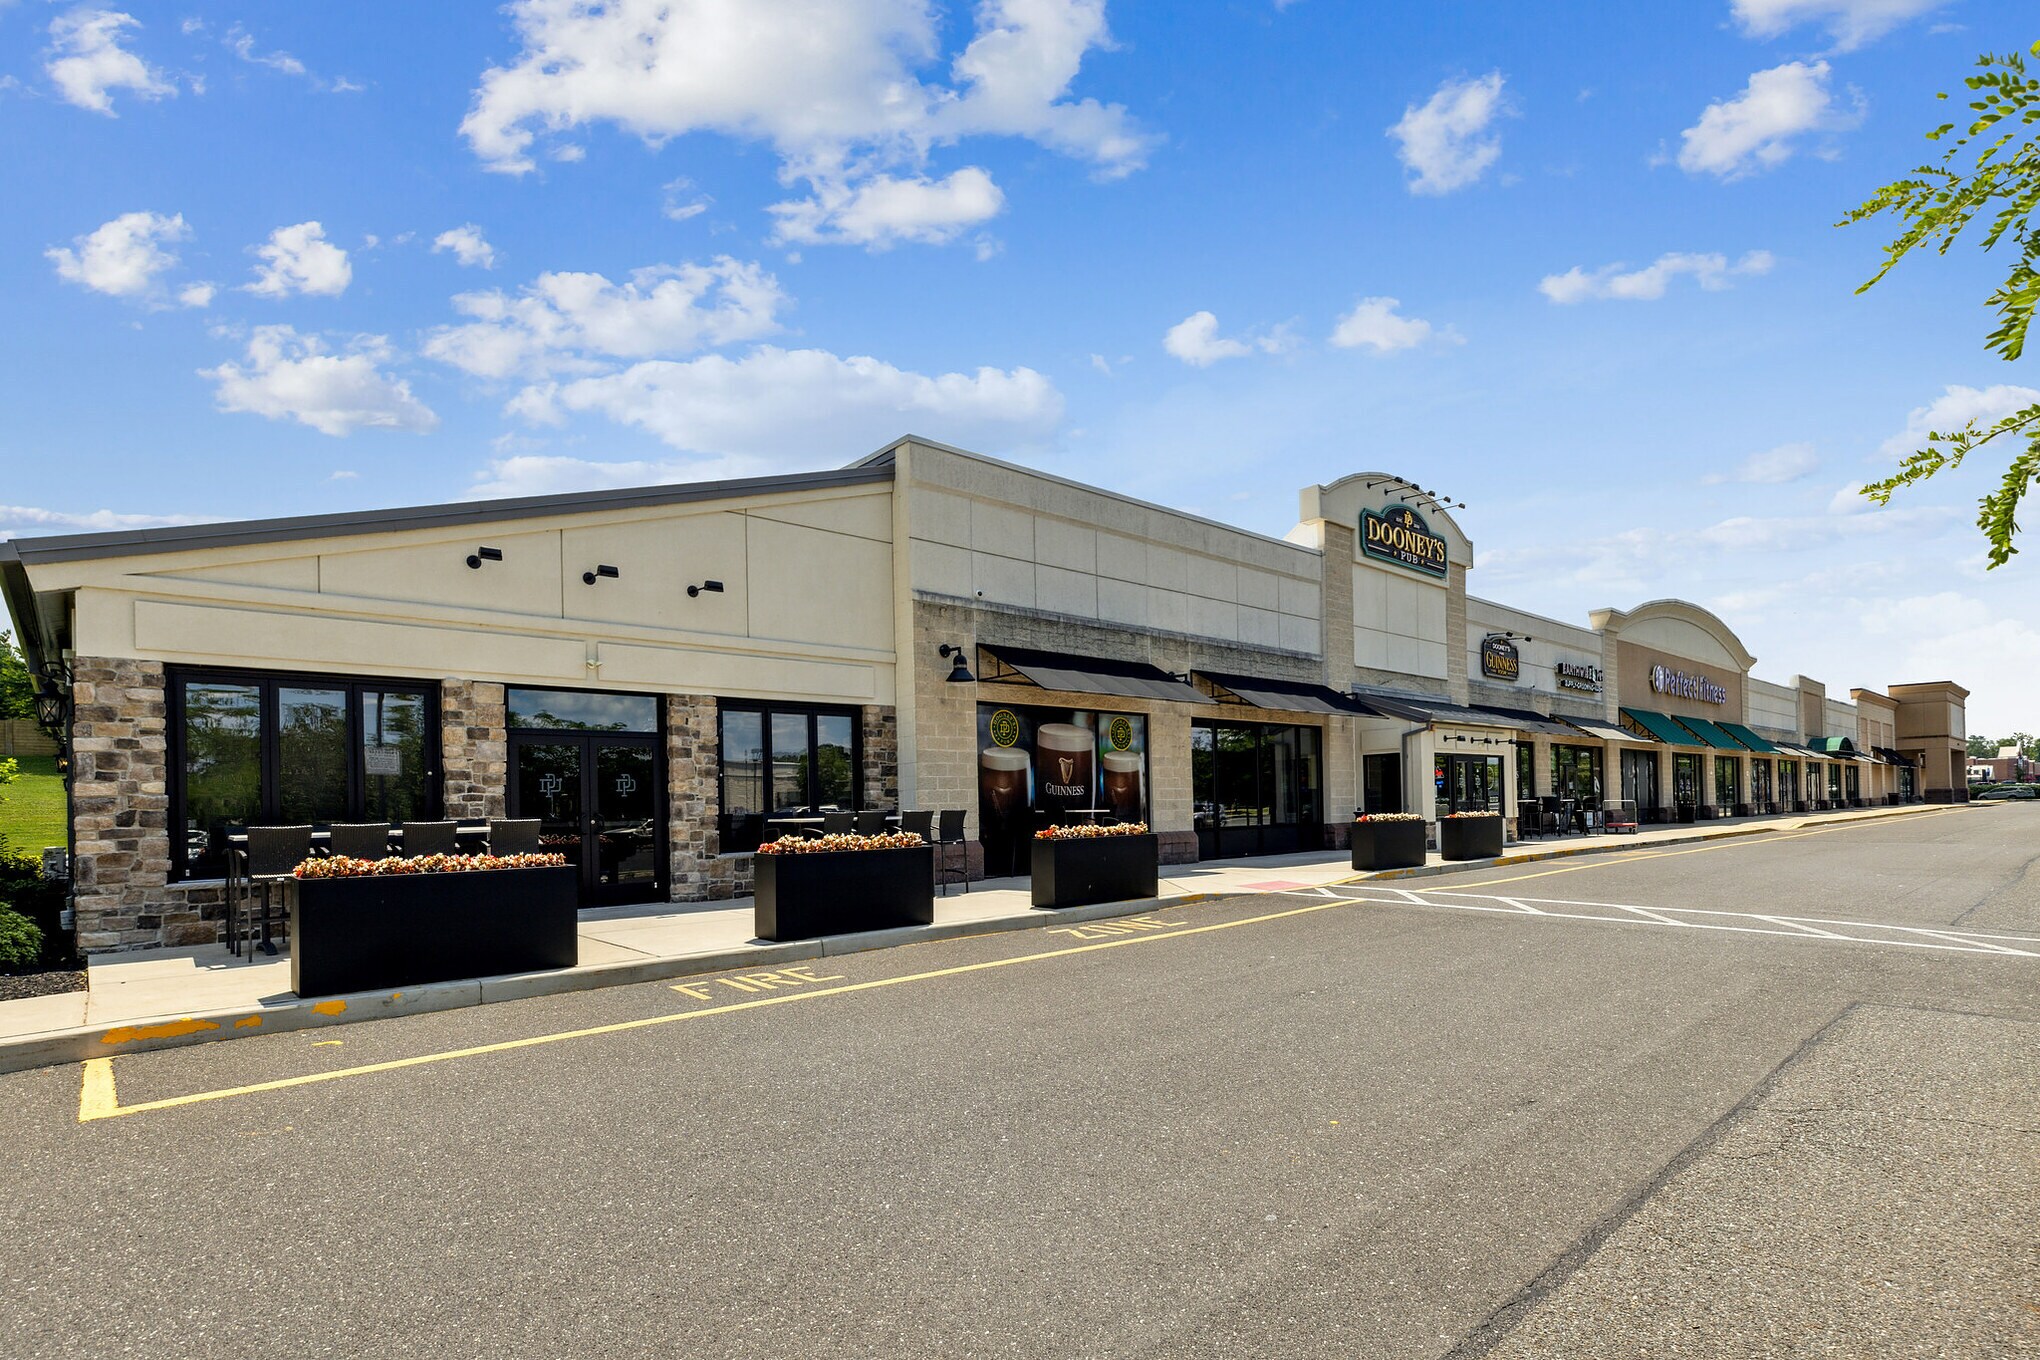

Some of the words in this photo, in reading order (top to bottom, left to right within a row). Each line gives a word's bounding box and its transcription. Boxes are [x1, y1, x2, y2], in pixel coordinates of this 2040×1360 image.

[1367, 517, 1445, 563] DOONEY'S
[1400, 551, 1418, 564] PUB
[1486, 650, 1518, 673] GUINNESS
[1664, 667, 1699, 699] Perfect
[1700, 675, 1726, 704] Fitness
[1045, 782, 1085, 796] GUINNESS
[669, 966, 845, 1000] FIRE
[1047, 916, 1189, 940] ZONE
